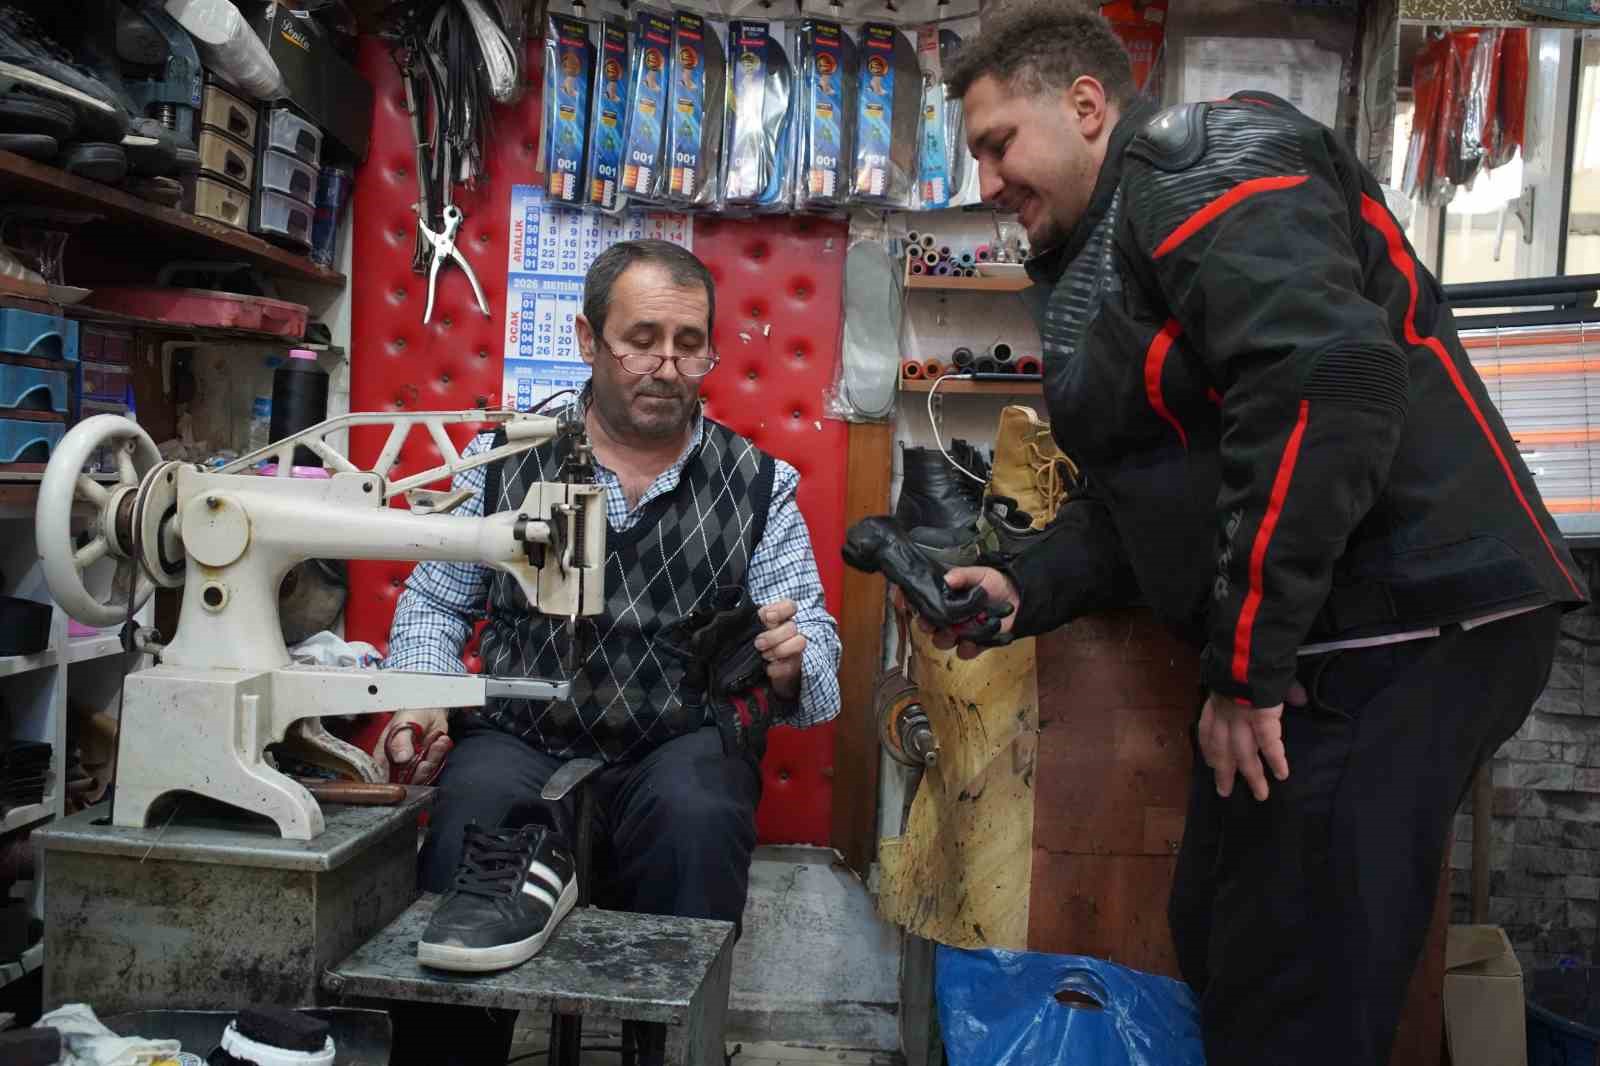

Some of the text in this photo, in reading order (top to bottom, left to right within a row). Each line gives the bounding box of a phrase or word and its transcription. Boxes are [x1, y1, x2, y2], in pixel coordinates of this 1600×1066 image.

[633, 150, 653, 163] 001
[677, 152, 696, 164] 001
[816, 156, 836, 166] 001
[557, 158, 577, 171] 001
[599, 165, 617, 177] 001
[513, 219, 523, 262] ARALIK
[586, 229, 599, 238] 10
[607, 230, 619, 238] 11
[629, 231, 641, 240] 12
[670, 232, 682, 241] 14
[543, 239, 556, 247] 15
[542, 249, 555, 258] 22
[562, 250, 576, 259] 23
[541, 261, 554, 270] 29
[561, 262, 576, 270] 30
[510, 311, 520, 344] OCAK
[539, 324, 551, 333] 12
[560, 325, 572, 334] 13
[538, 335, 551, 344] 19
[558, 336, 572, 345] 20
[536, 346, 550, 355] 26
[557, 348, 570, 356] 27
